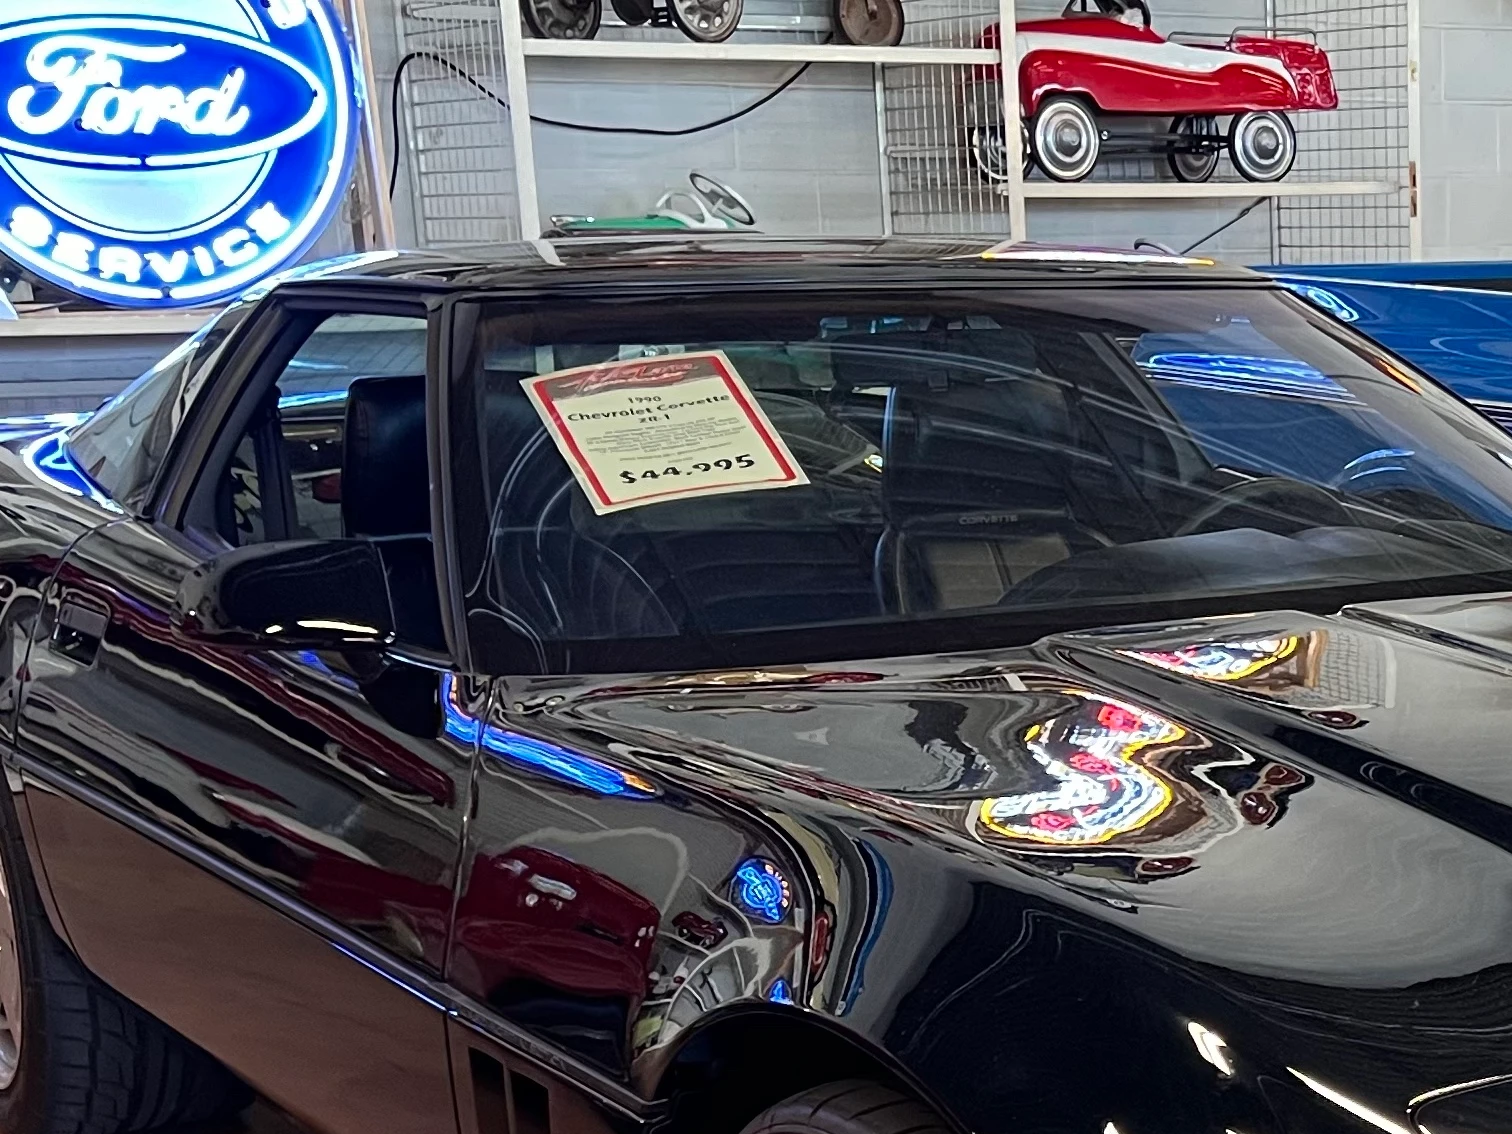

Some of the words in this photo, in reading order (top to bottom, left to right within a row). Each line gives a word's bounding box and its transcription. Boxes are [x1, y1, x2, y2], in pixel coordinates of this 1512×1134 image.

[8, 36, 250, 136] Ford
[8, 202, 291, 283] SERVICE
[567, 407, 653, 422] Chevrolet
[656, 394, 731, 412] Corvette
[628, 395, 662, 404] 1990
[958, 513, 1018, 525] CORVETTE
